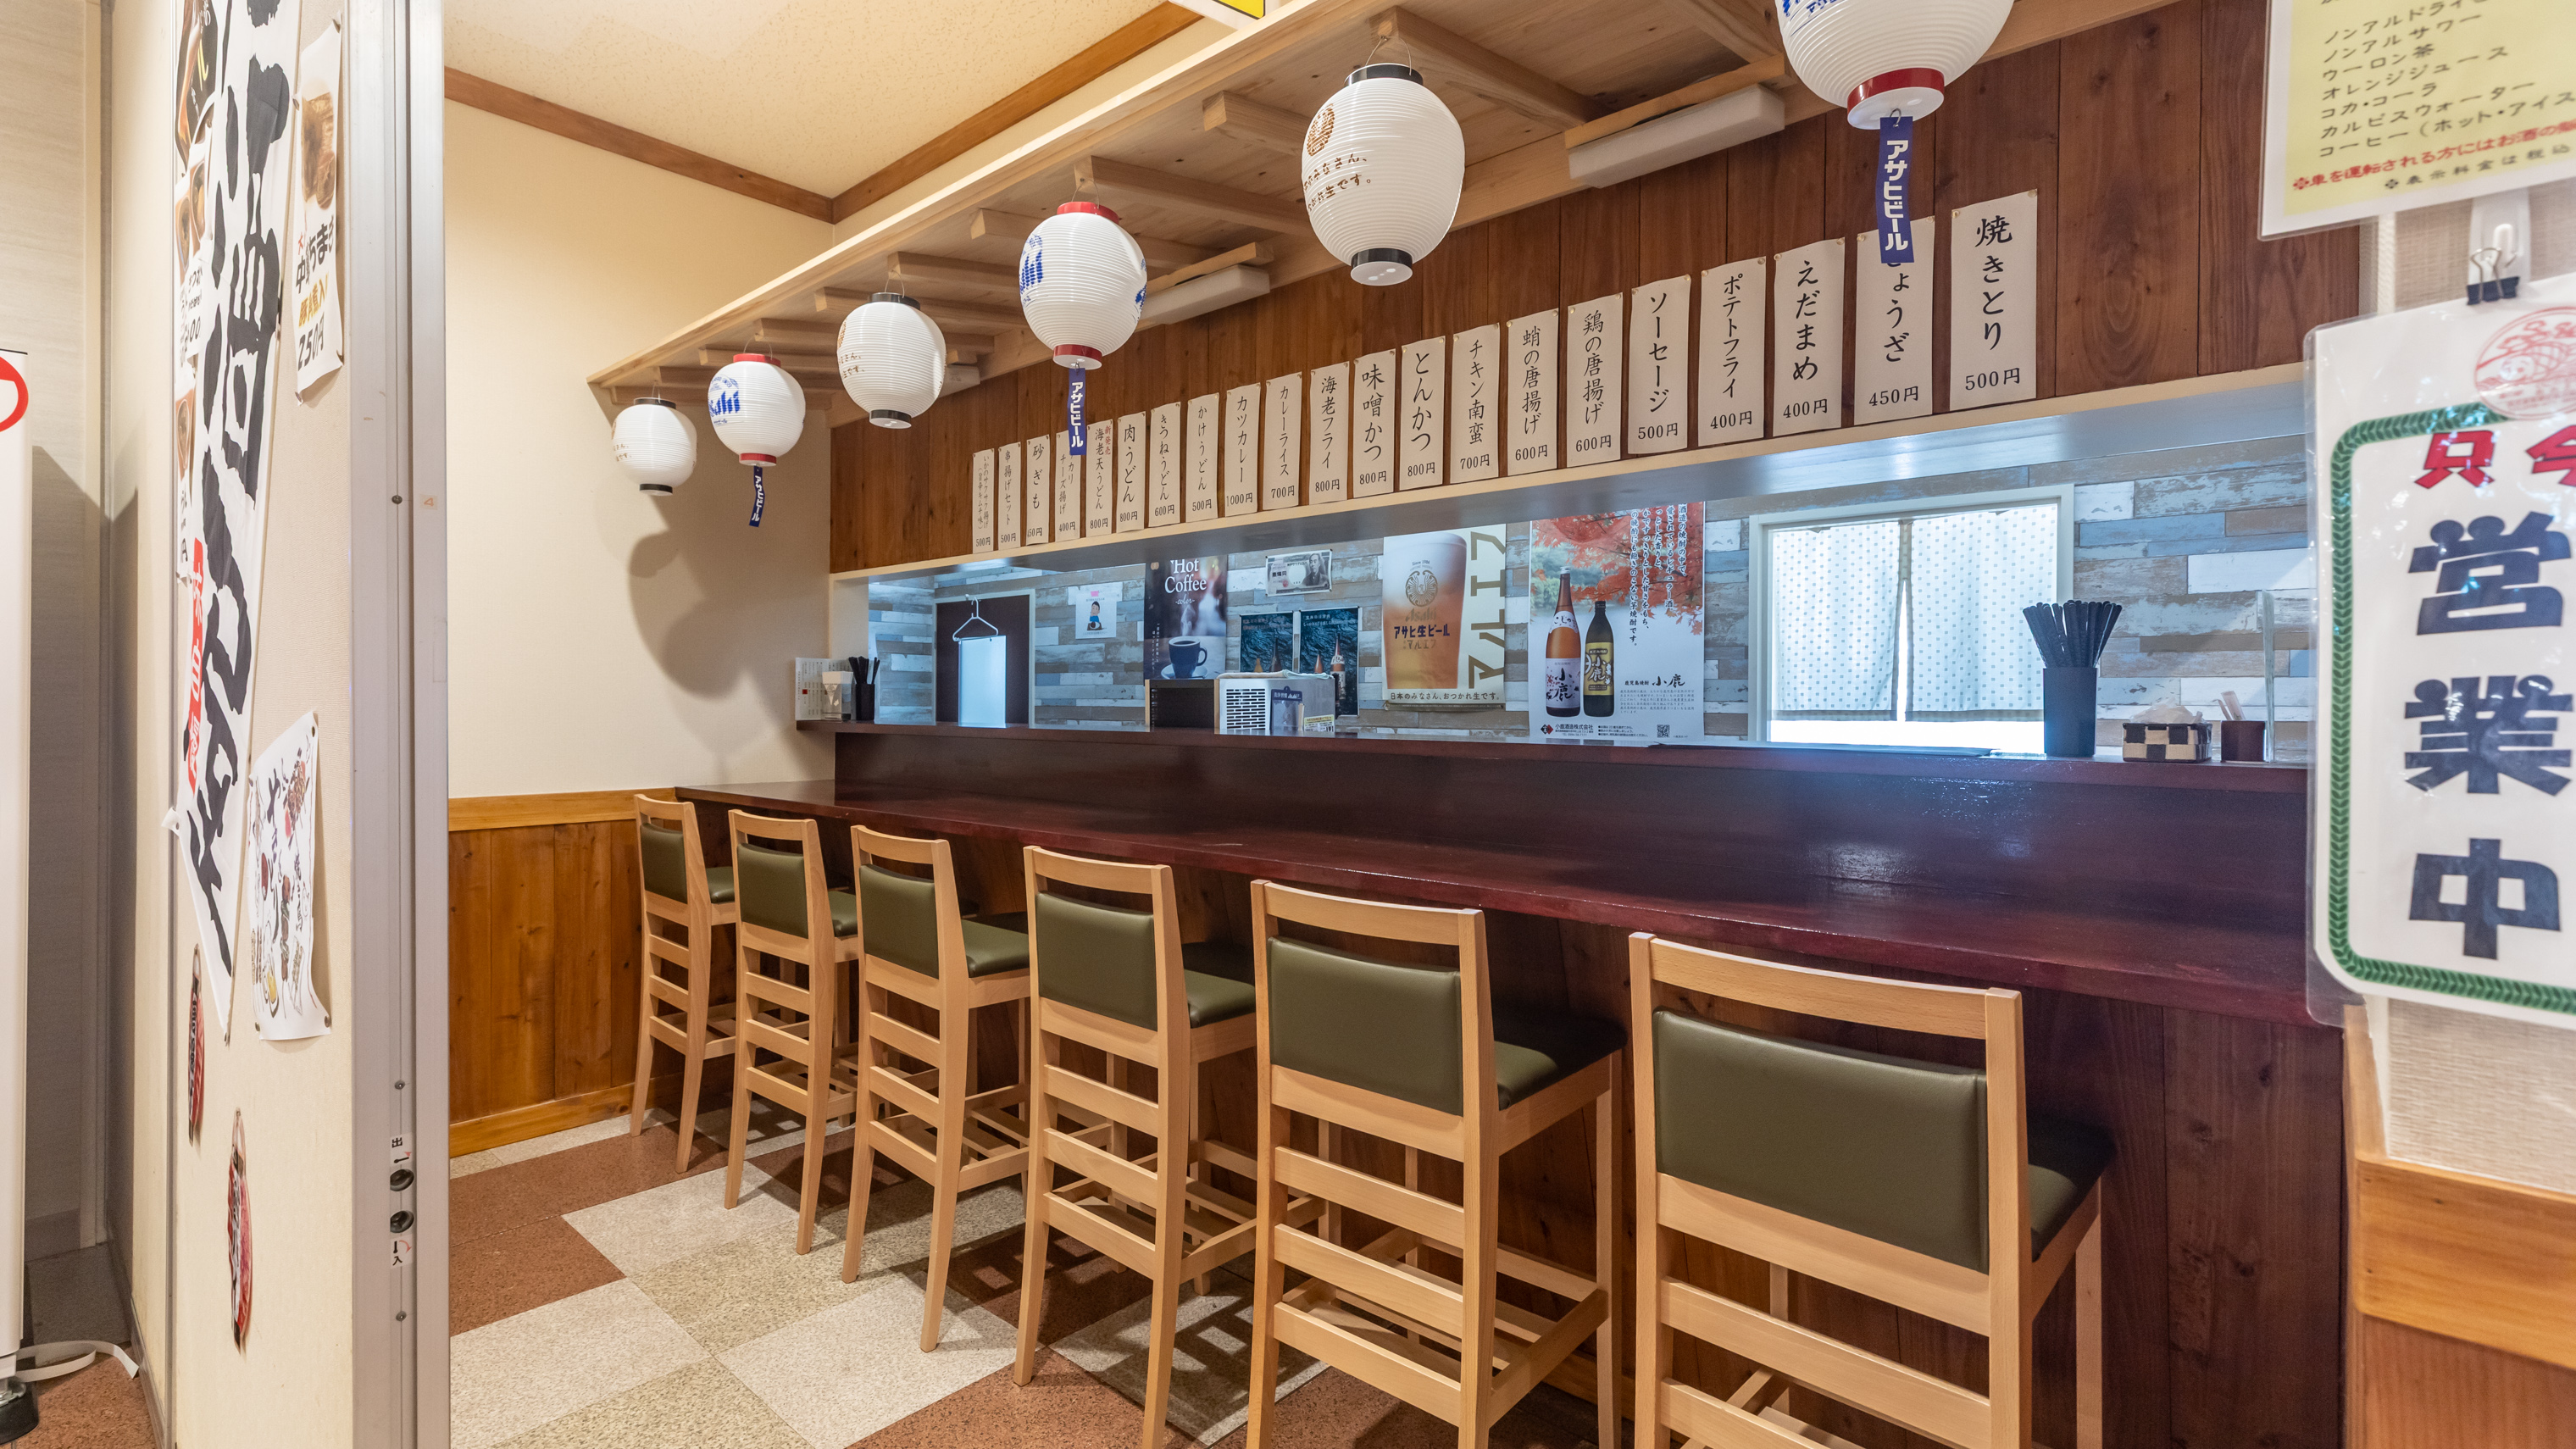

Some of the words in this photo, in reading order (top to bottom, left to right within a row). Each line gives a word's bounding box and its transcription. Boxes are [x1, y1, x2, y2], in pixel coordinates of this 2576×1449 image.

[2323, 14, 2482, 63] ノンアルサワー
[2322, 46, 2508, 101] オレンジジュース
[2323, 44, 2434, 81] ウーロン茶
[2321, 82, 2437, 119] コカ・コーラ
[1884, 140, 1908, 251] アサヒビール
[1975, 214, 2012, 351] 焼きとり
[1792, 260, 1820, 381] えだまめ
[1883, 262, 1910, 363] ょうざ
[1722, 273, 1744, 398] ポテトフライ
[1583, 309, 1604, 425] 鶏の唐揚げ
[1648, 292, 1669, 413] ソーセージ
[1468, 339, 1485, 445] チキン南蛮
[1522, 325, 1542, 435] 蛸の唐揚げ
[1964, 367, 2021, 391] 500円
[1411, 353, 1434, 452] とんかつ
[1783, 398, 1829, 419] 400円
[1868, 386, 1919, 407] 450円
[1069, 381, 1084, 447] アサヒビール
[1321, 375, 1337, 469] 海老フライ
[1362, 364, 1385, 461] 味噌かつ
[1710, 410, 1752, 430] 400円
[1237, 396, 1247, 483] カツカレー
[1279, 386, 1290, 476] カレーライス
[1575, 435, 1612, 452] 600円
[1638, 423, 1679, 440] 500円
[1123, 425, 1136, 502] 肉うどん
[1198, 406, 1208, 491] かけうどん
[1460, 454, 1490, 470] 700円
[1515, 444, 1548, 461] 600円
[1033, 444, 1044, 509] 砂ぎも
[1095, 428, 1104, 509] 海老天うどん
[1359, 470, 1387, 486] 800円
[1407, 462, 1435, 477] 800円
[1226, 492, 1253, 507] 1000円
[1271, 485, 1295, 499] 700円
[1315, 479, 1340, 492] 800円
[1119, 511, 1138, 522] 800円
[1155, 504, 1174, 516] 600円
[1192, 499, 1212, 512] 500円
[1001, 533, 1016, 543] 500円
[1059, 521, 1076, 532] 400円
[1090, 518, 1108, 529] 800円
[1654, 507, 1663, 569] っとした香りと、
[976, 536, 991, 547] 500円
[1678, 503, 1688, 577] 酒造の焼酎の中で、
[1173, 558, 1199, 575] Hot
[1642, 508, 1651, 628] かですっきりとした甘さをもち、
[1164, 574, 1208, 594] Coffee
[1394, 624, 1450, 639] アサヒ生ビール
[1391, 691, 1500, 701] 日本のみなさん、おつかれ生です。
[1652, 674, 1685, 688] 小鹿
[2404, 511, 2575, 961] 営業中
[391, 1137, 403, 1148] 出
[392, 1255, 402, 1266] 入
